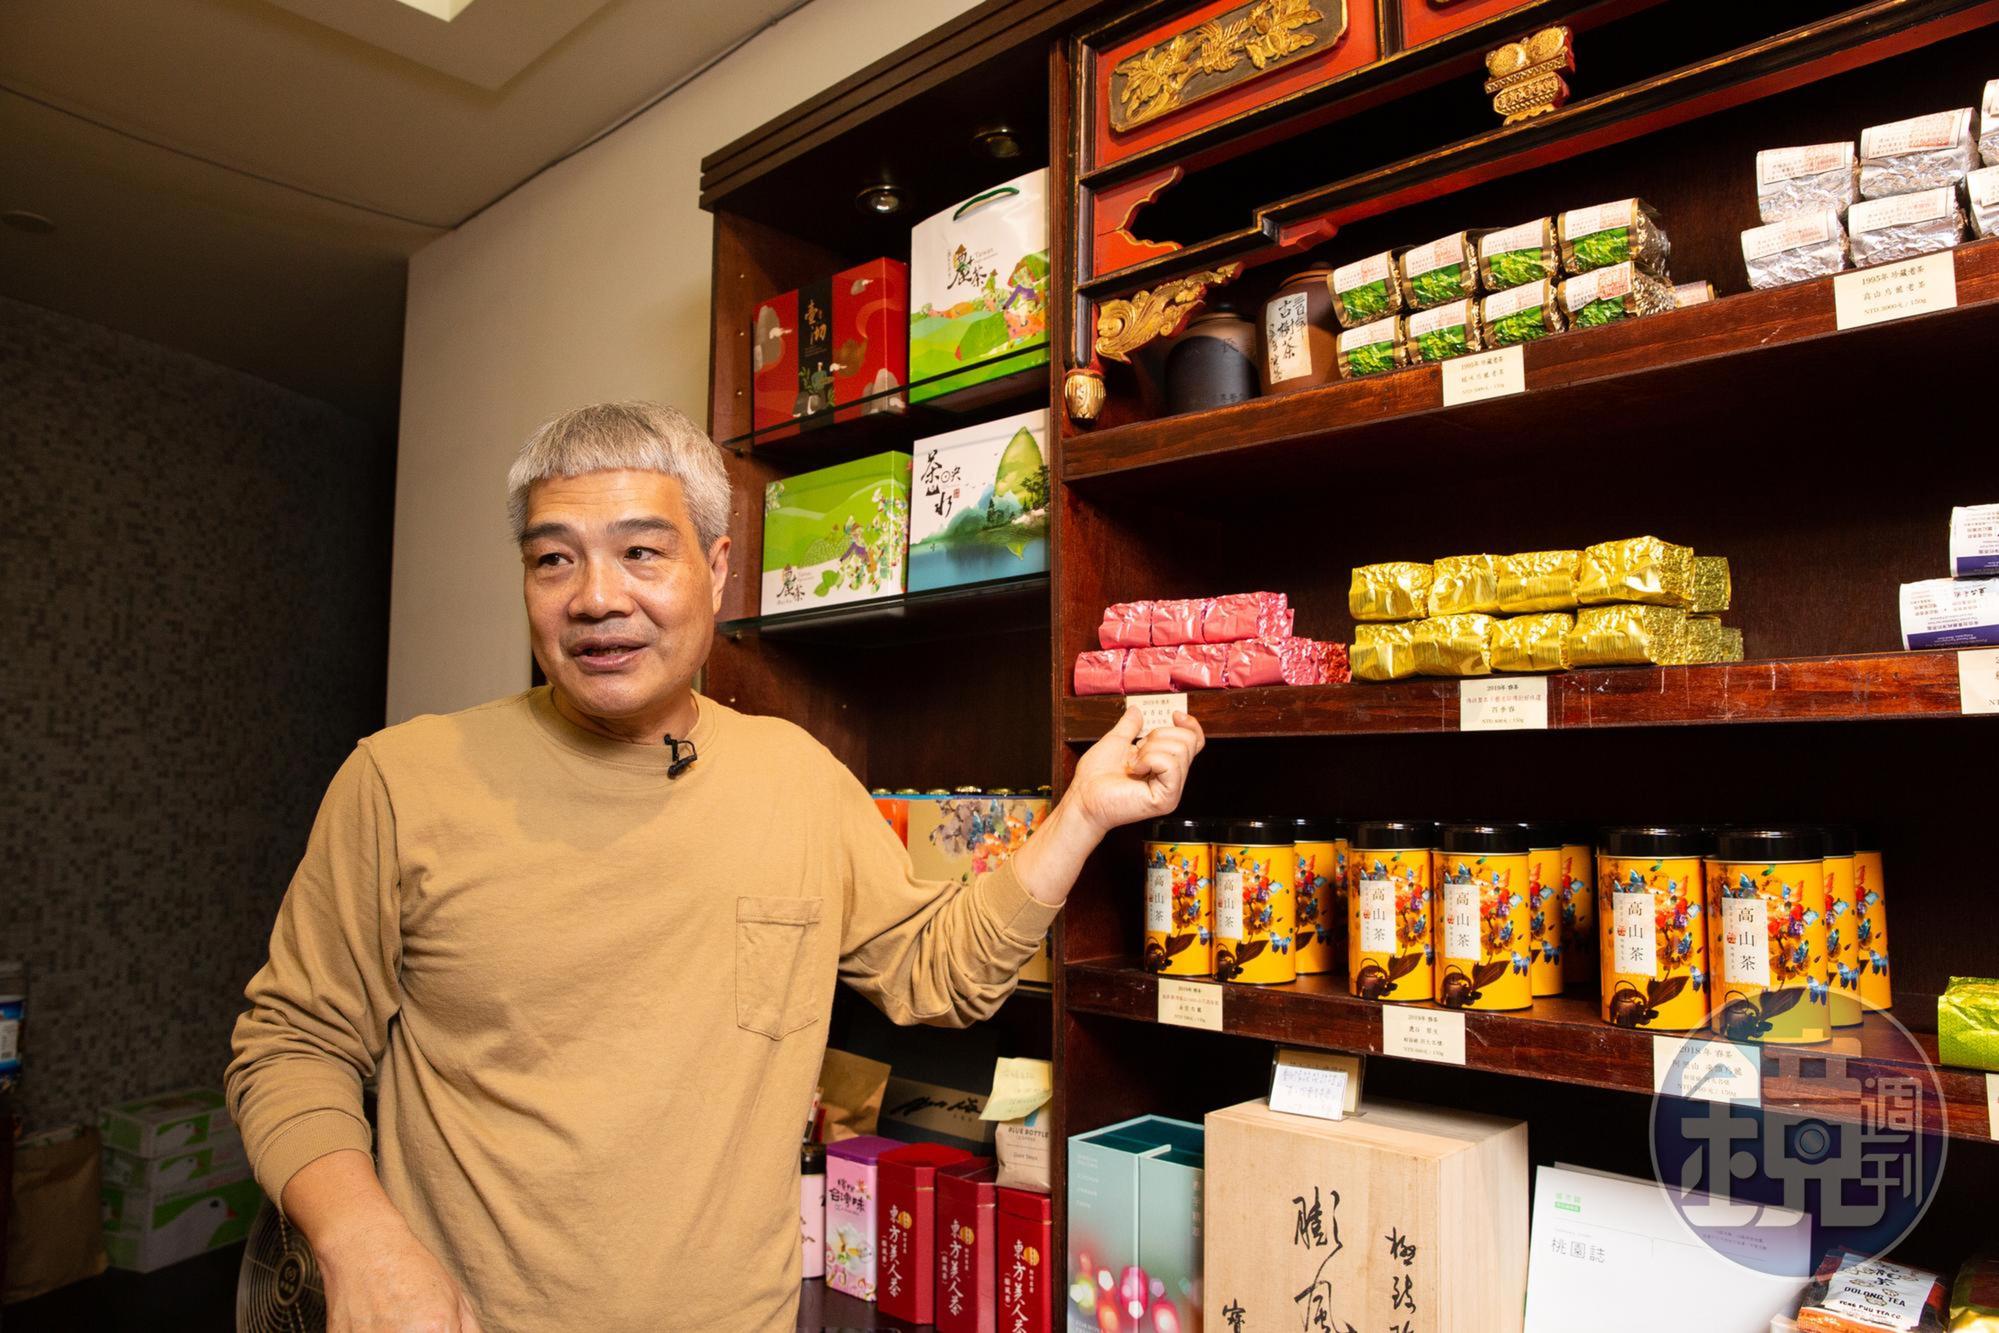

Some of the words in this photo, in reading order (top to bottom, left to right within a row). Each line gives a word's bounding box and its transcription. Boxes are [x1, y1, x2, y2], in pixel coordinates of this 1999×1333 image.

[1154, 875, 1165, 922] 高山茶
[1224, 880, 1235, 928] 高山茶
[1372, 888, 1386, 941] 高山茶
[1456, 892, 1470, 947] 高山茶
[1628, 901, 1644, 961] 高山茶
[1738, 907, 1756, 971] 高山茶
[1025, 1127, 1049, 1139] BOTTLE
[888, 1204, 903, 1298] 東方美人茶
[948, 1219, 964, 1316] 東方美人茶
[1552, 1237, 1606, 1264] 桃園誌
[1888, 1295, 1906, 1307] TEA
